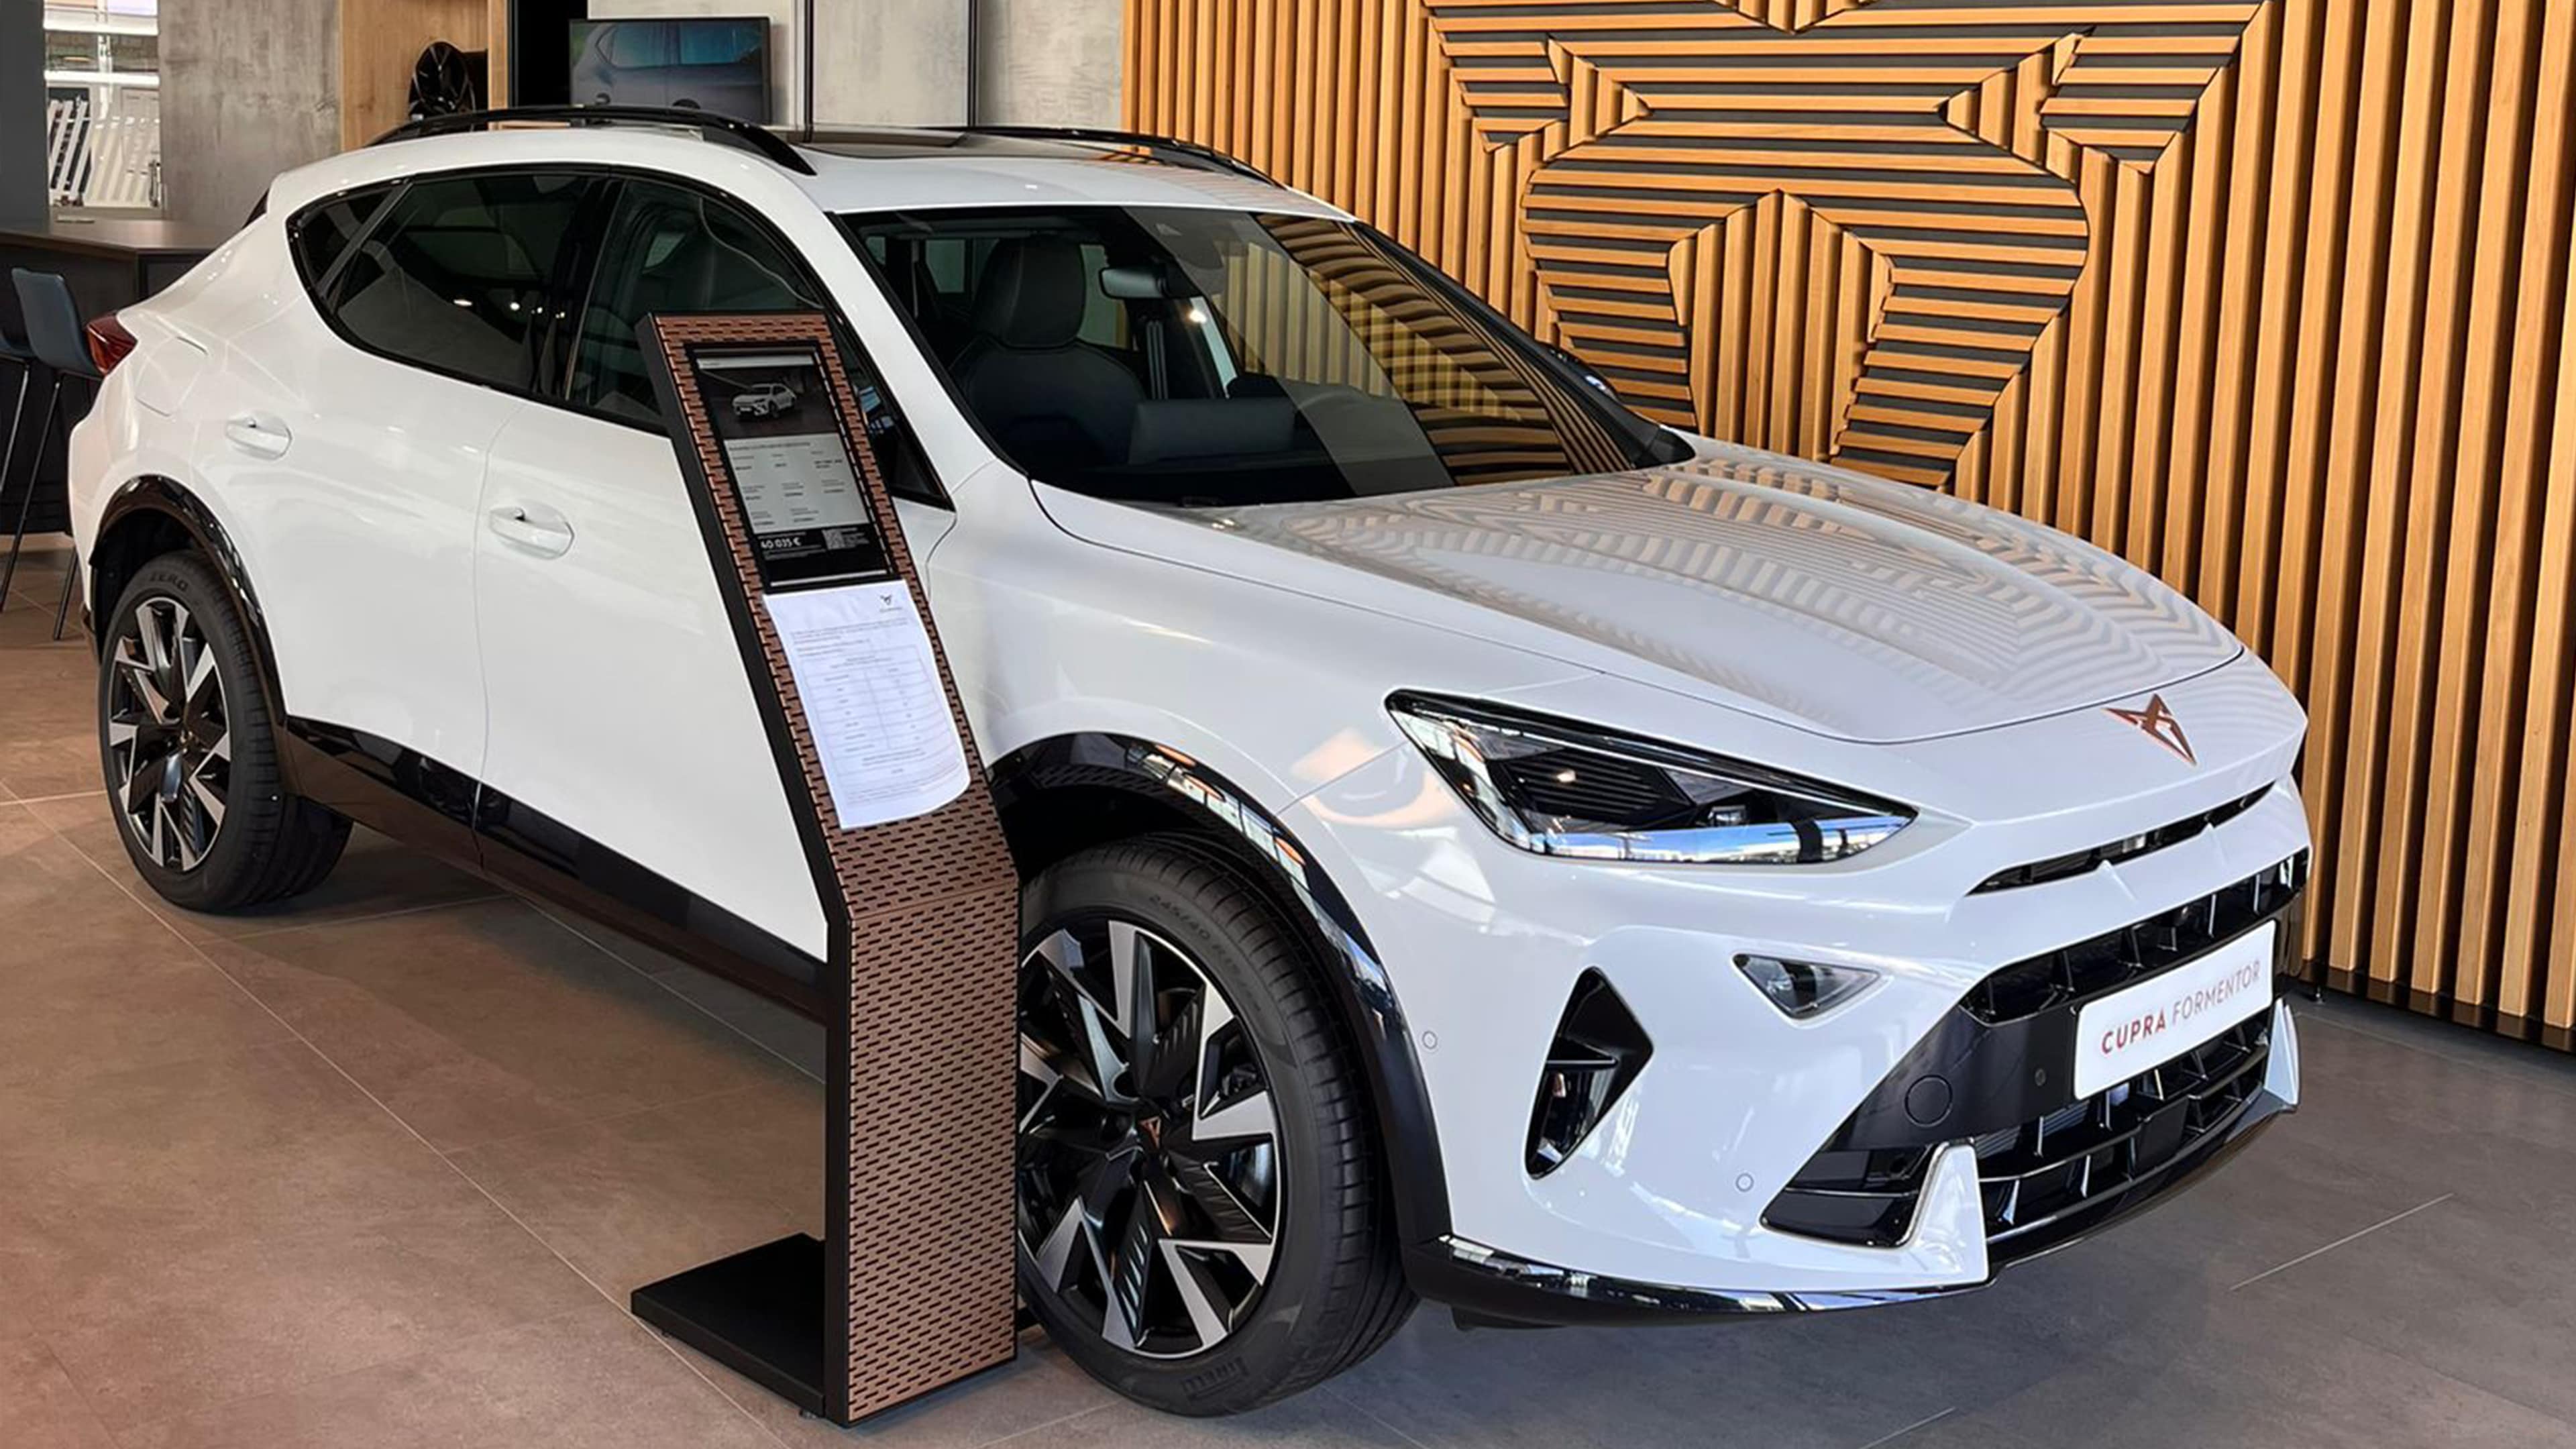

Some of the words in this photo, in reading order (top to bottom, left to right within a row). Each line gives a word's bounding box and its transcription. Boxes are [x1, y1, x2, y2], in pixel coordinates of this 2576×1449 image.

[150, 572, 189, 592] ZERO
[2101, 1008, 2166, 1054] CUPRA
[2171, 959, 2261, 1025] FORMENTOR
